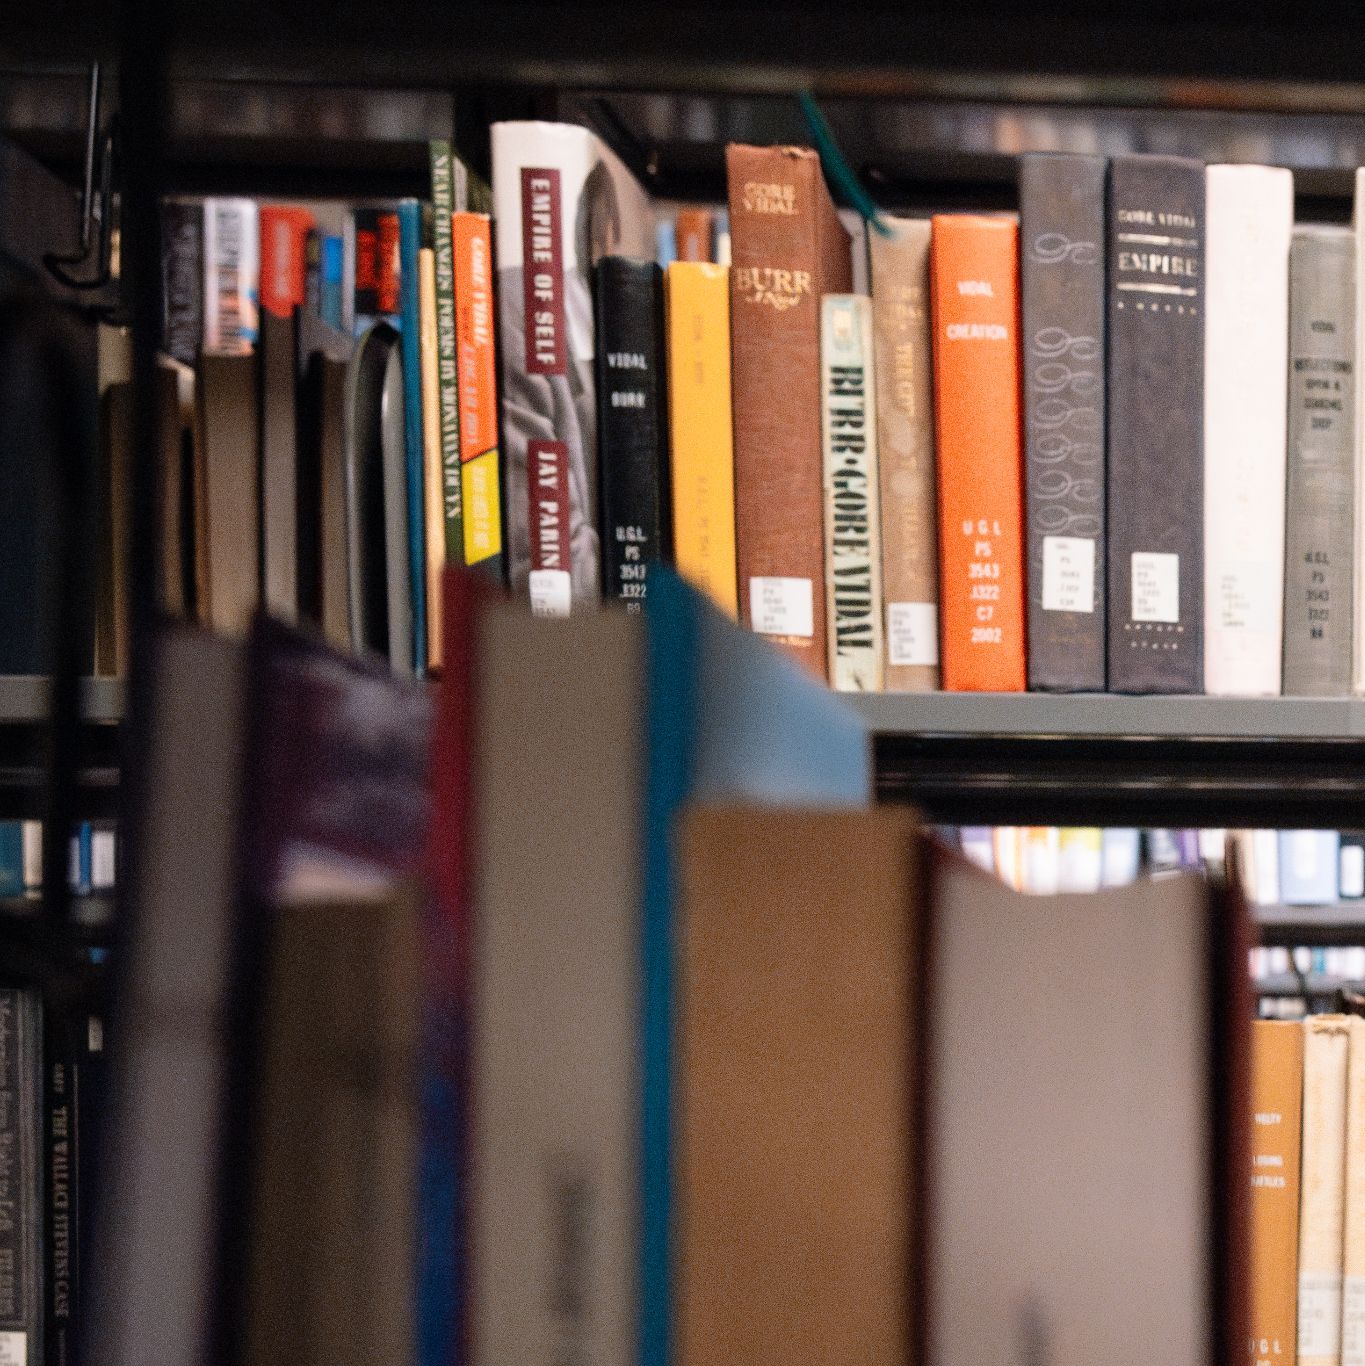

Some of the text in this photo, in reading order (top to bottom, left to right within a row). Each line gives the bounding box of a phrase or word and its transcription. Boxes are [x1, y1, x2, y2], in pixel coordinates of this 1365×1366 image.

[531, 178, 556, 365] EMPIRE OF SELF
[1118, 252, 1198, 277] EMPIRE
[736, 268, 812, 292] BURR
[956, 281, 994, 297] VIDAL
[945, 324, 1008, 341] CREATION
[607, 353, 648, 369] VIDAL
[538, 450, 559, 489] JAY
[833, 468, 870, 557] GORE
[539, 500, 561, 568] PARIN
[625, 545, 641, 561] PS
[975, 541, 992, 557] PS
[835, 563, 875, 657] VIDAL
